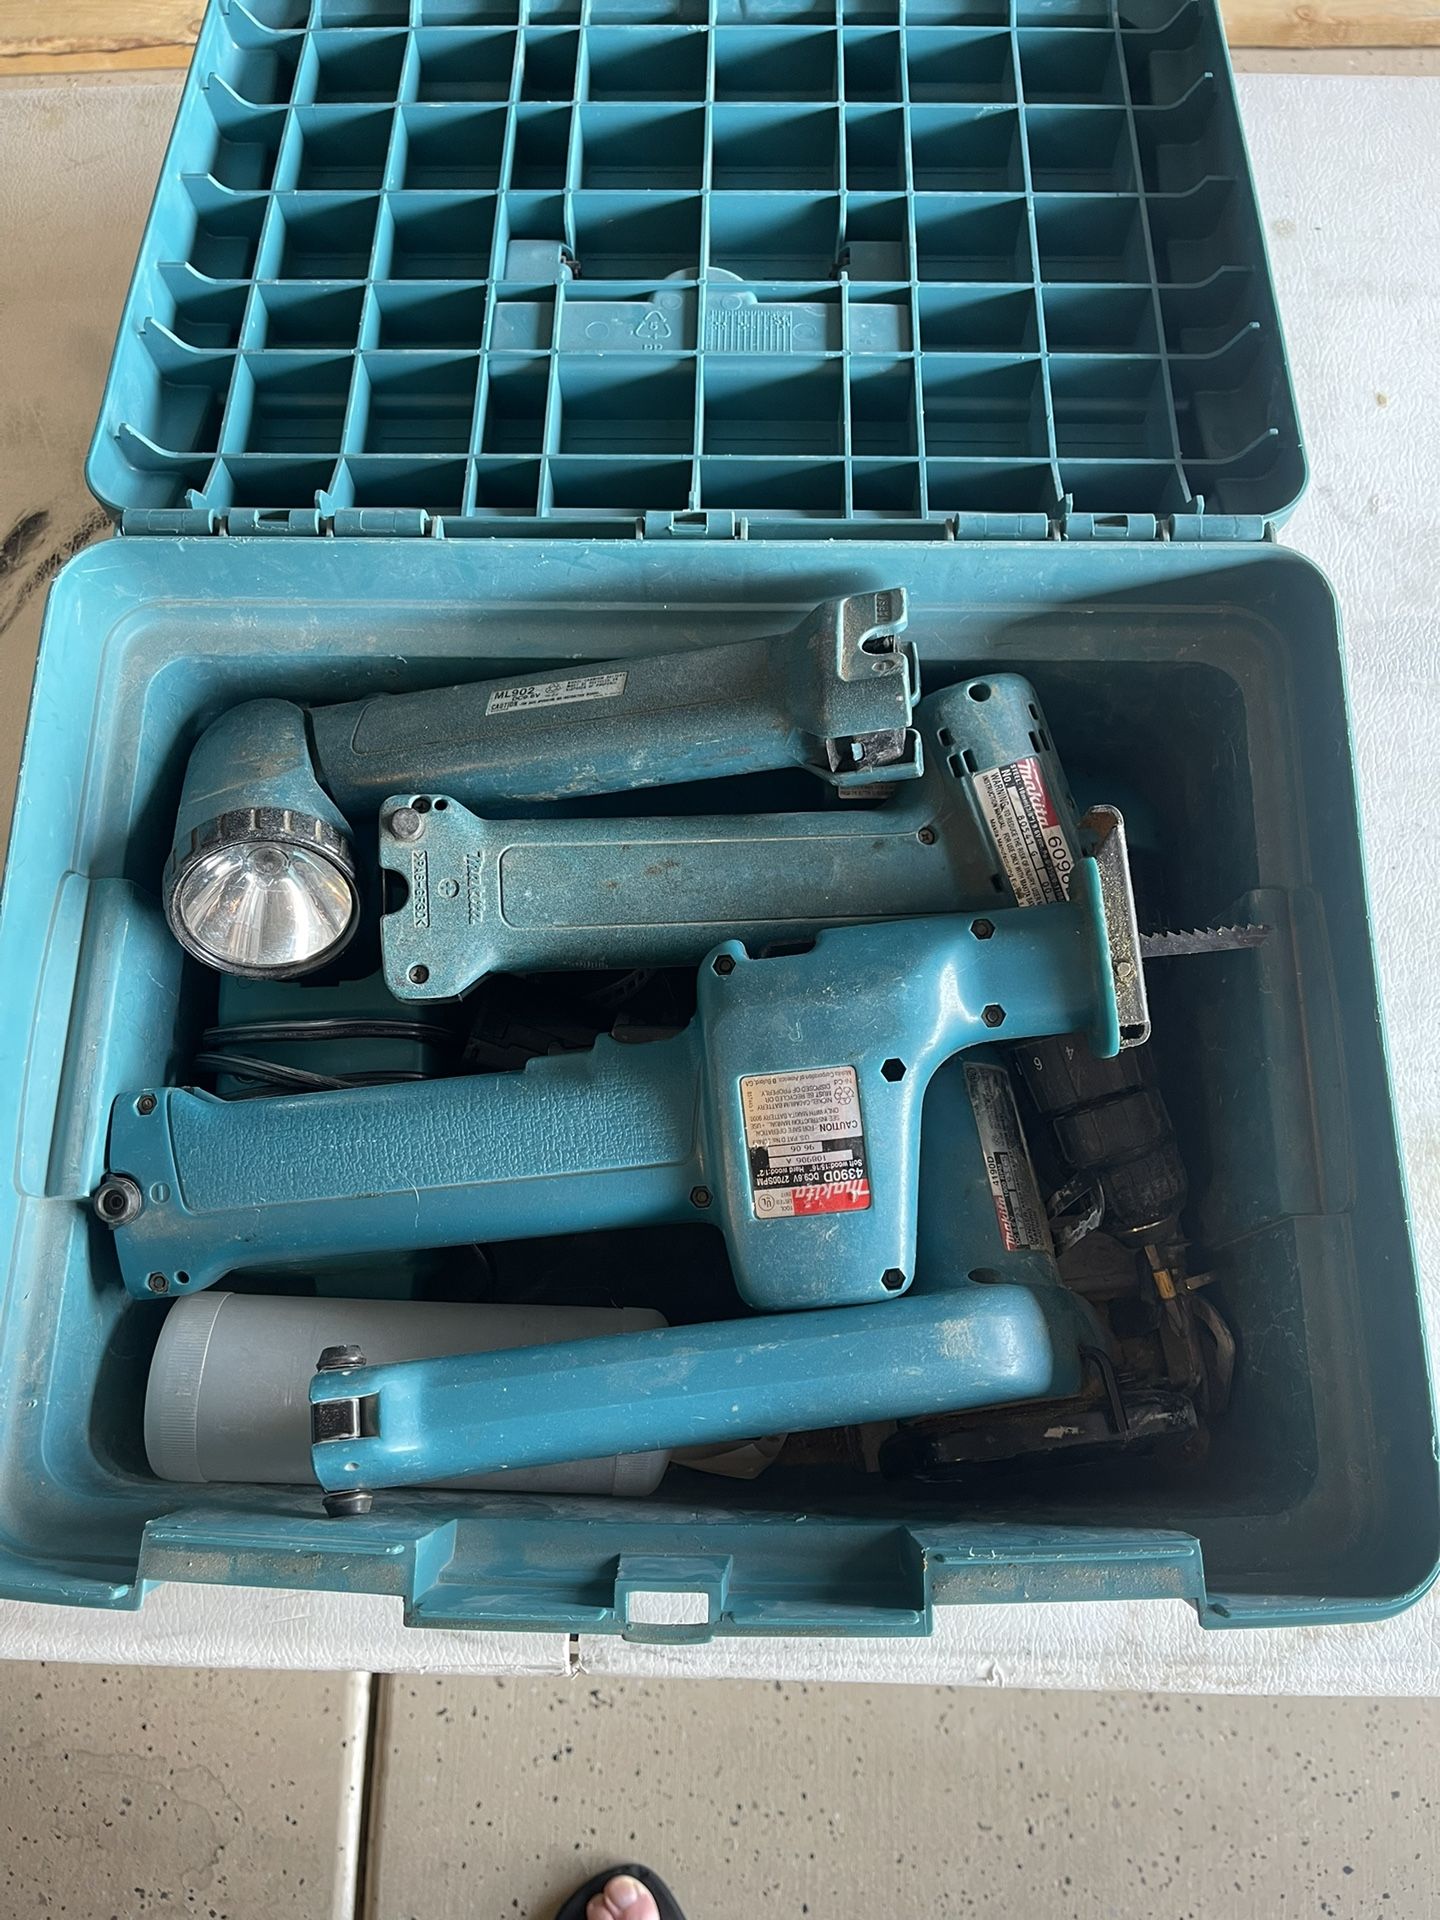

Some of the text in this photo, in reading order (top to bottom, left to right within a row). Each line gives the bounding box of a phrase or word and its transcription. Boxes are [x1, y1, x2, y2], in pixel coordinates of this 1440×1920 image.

[493, 686, 535, 699] ML902
[1000, 768, 1014, 785] No.
[1002, 832, 1011, 843] FOR
[1013, 837, 1022, 848] THE
[1006, 842, 1015, 853] USE
[1010, 852, 1019, 865] ONLY
[1016, 847, 1026, 860] RISK
[1021, 859, 1028, 867] OF
[1014, 865, 1024, 879] WITH
[800, 1082, 830, 1091] DISPOSED
[773, 1092, 805, 1102] RECYCLED
[756, 1102, 782, 1110] BATTERY
[823, 1106, 839, 1114] ONLY
[763, 1112, 787, 1121] BATTERY
[788, 1110, 807, 1118] MAKITA
[791, 1115, 827, 1125] INSTRUCTION
[795, 1154, 826, 1163] 108906
[848, 1158, 862, 1167] Soft
[788, 1165, 804, 1173] Hard
[822, 1166, 863, 1182] 4390D
[985, 1155, 1000, 1185] 4190D
[792, 1172, 819, 1182] DC9.6V
